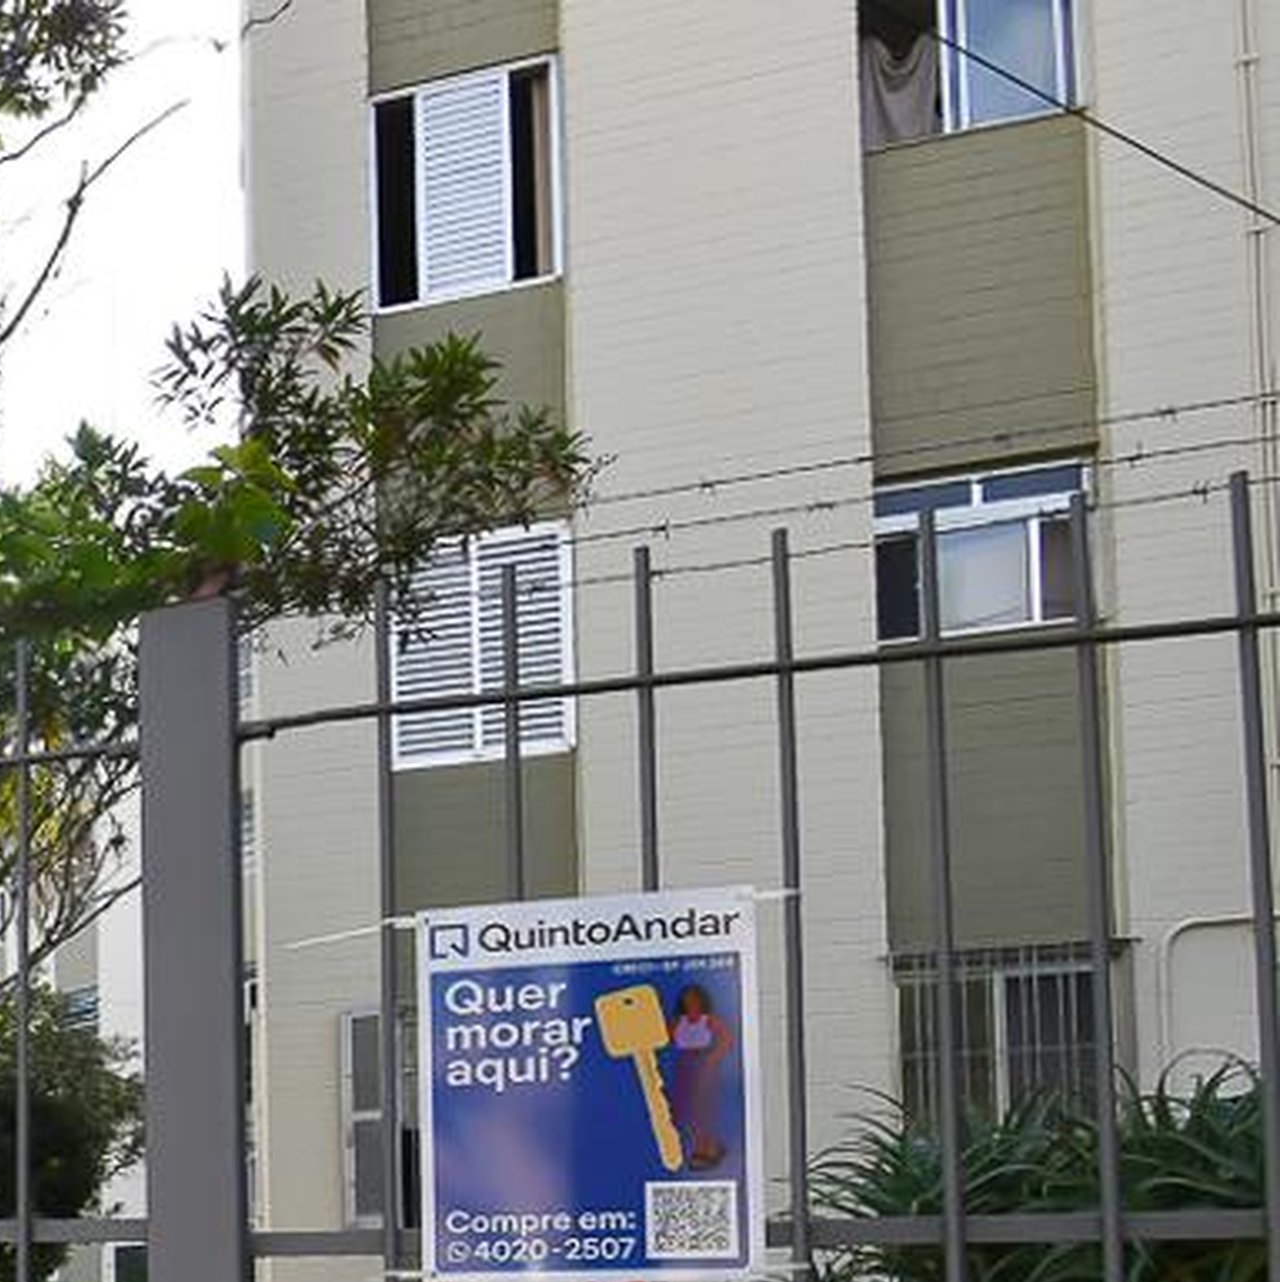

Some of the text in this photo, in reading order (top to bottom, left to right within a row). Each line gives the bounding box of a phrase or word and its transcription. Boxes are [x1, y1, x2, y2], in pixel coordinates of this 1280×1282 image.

[478, 909, 741, 953] QuintoAndar
[445, 979, 567, 1016] Quer
[445, 1015, 592, 1051] morar
[445, 1047, 579, 1092] aqui?
[445, 1209, 637, 1236] Compre em:
[473, 1237, 637, 1262] 4020-2507
